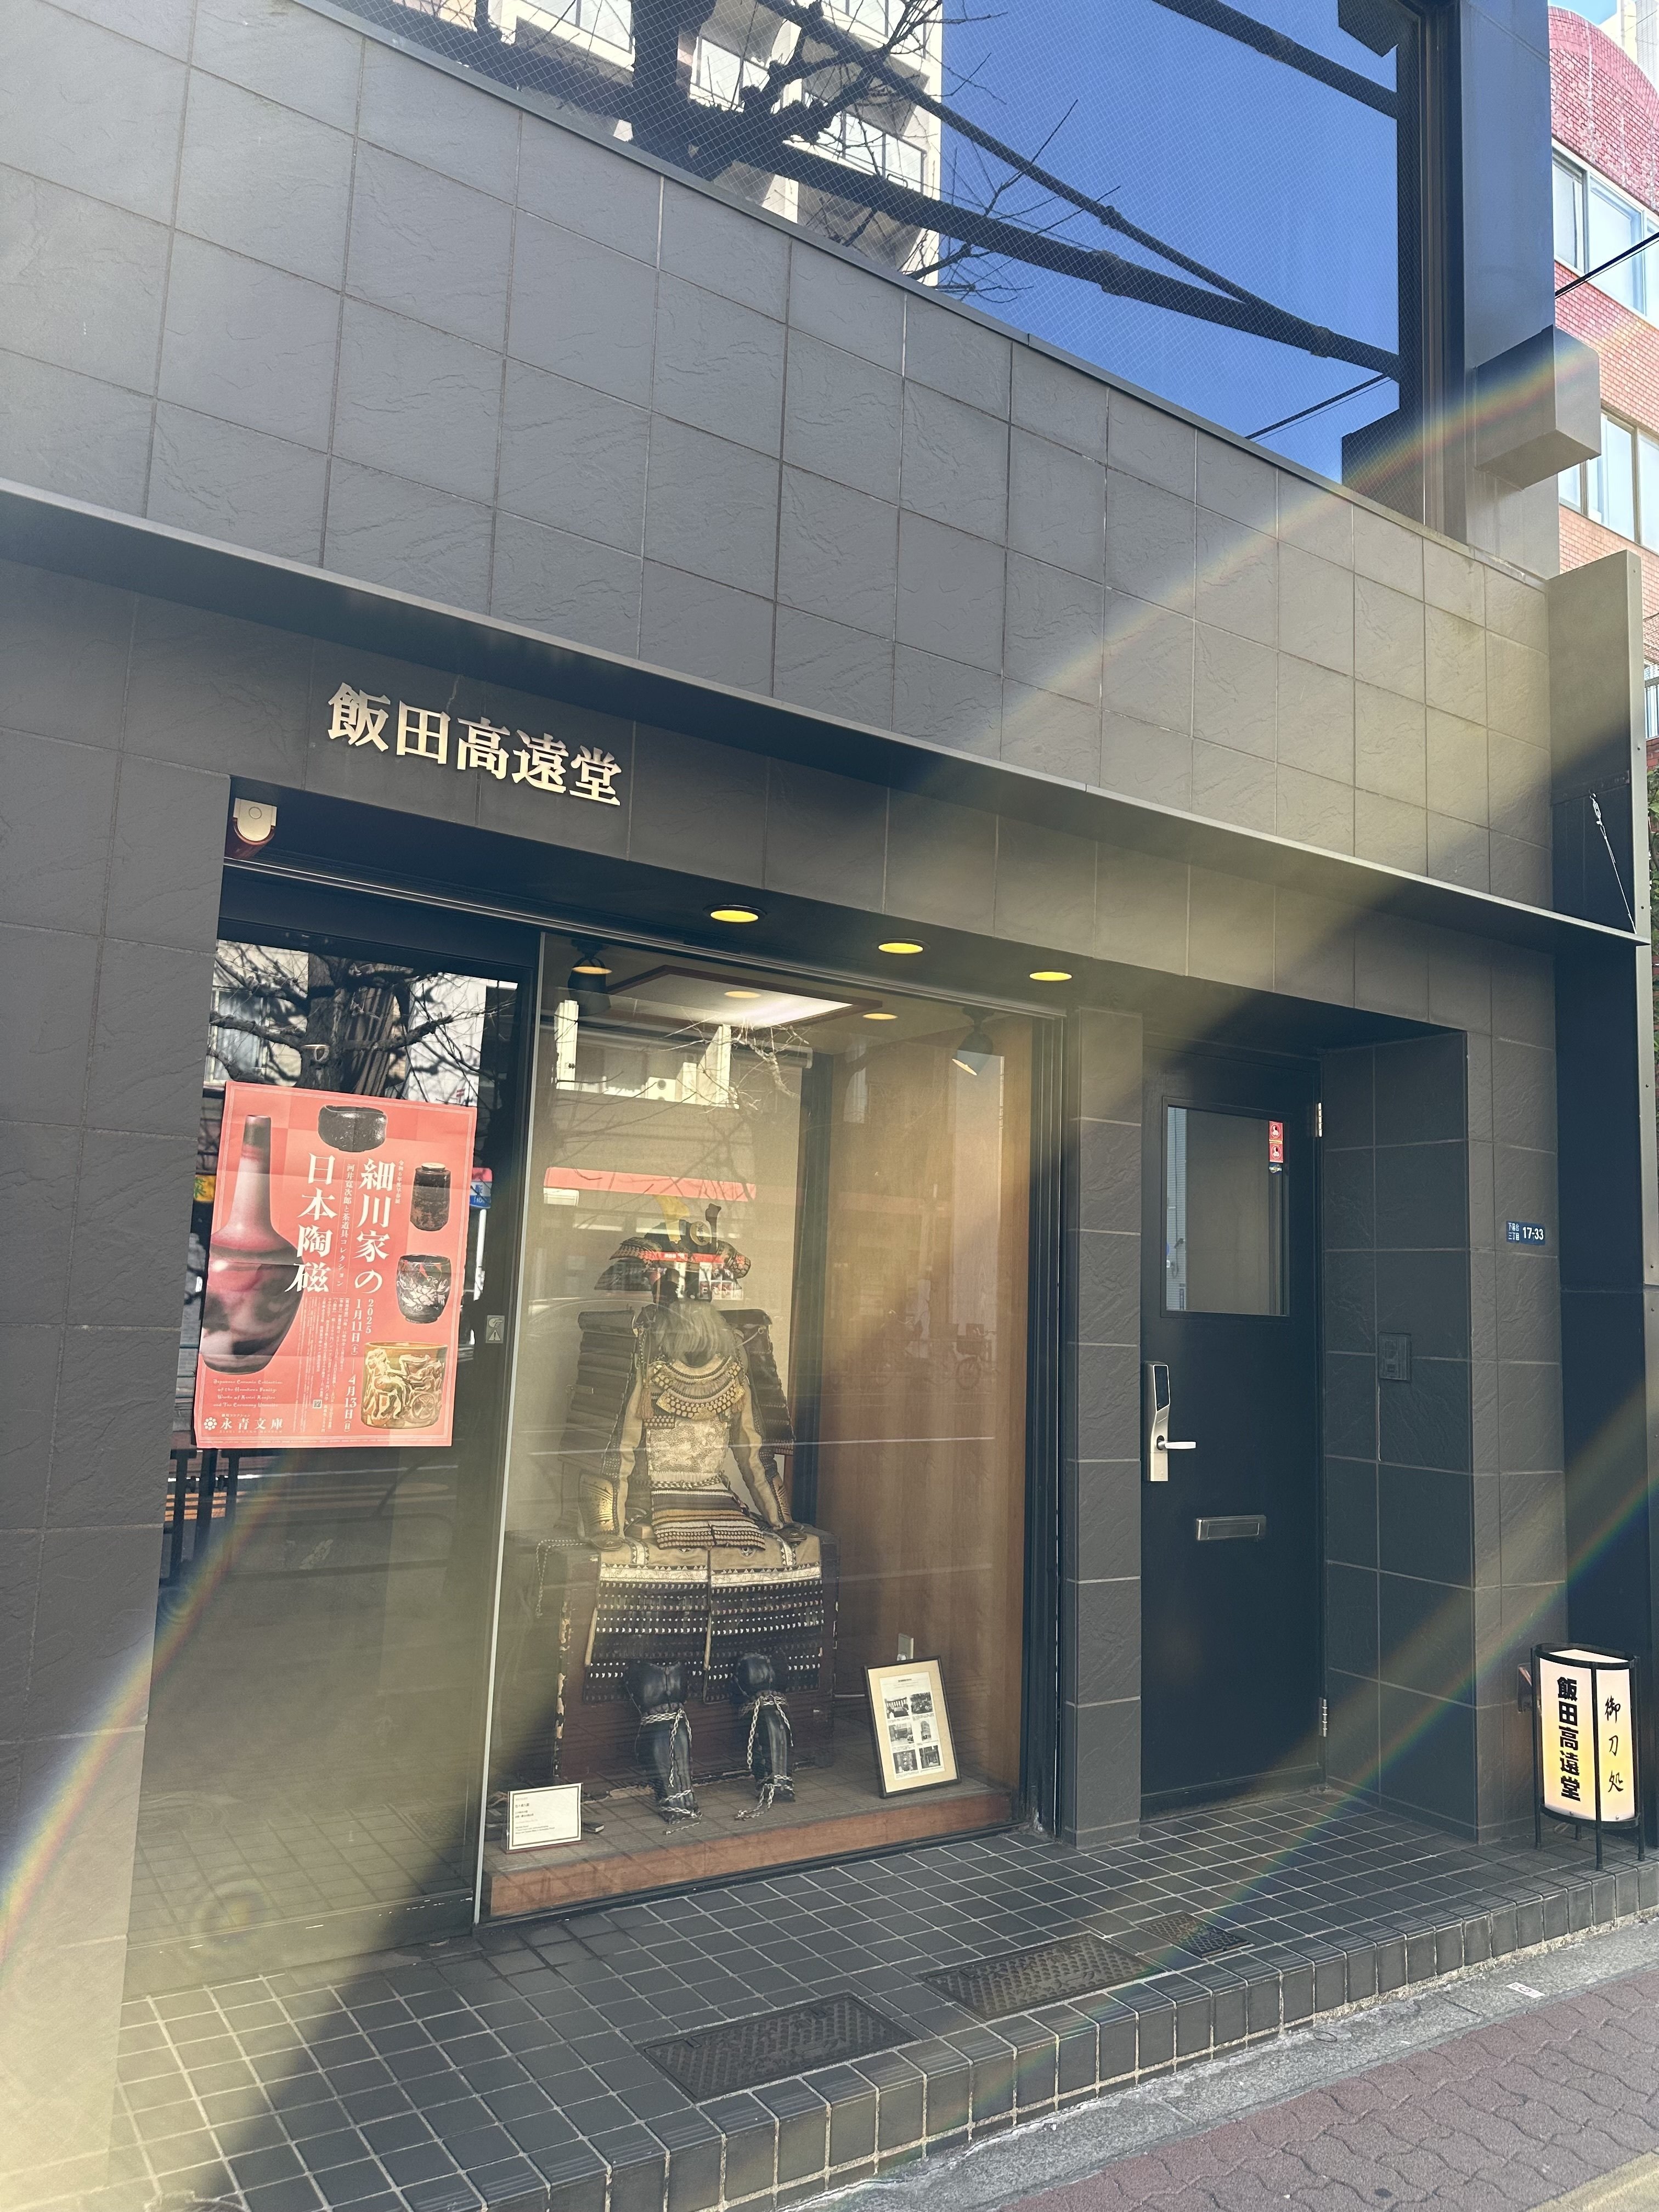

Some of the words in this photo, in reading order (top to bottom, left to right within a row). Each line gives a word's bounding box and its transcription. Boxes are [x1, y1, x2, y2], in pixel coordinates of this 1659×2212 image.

[328, 682, 622, 806] 飯田高遠堂
[284, 1152, 338, 1293] 日本陶磁
[352, 1158, 396, 1294] 細川家の
[1522, 1226, 1544, 1240] 17-33
[365, 1299, 374, 1334] 2025
[219, 1417, 283, 1430] 永青文庫
[1556, 1676, 1581, 1802] 飯田高遠堂
[1605, 1695, 1624, 1793] 御刀処
